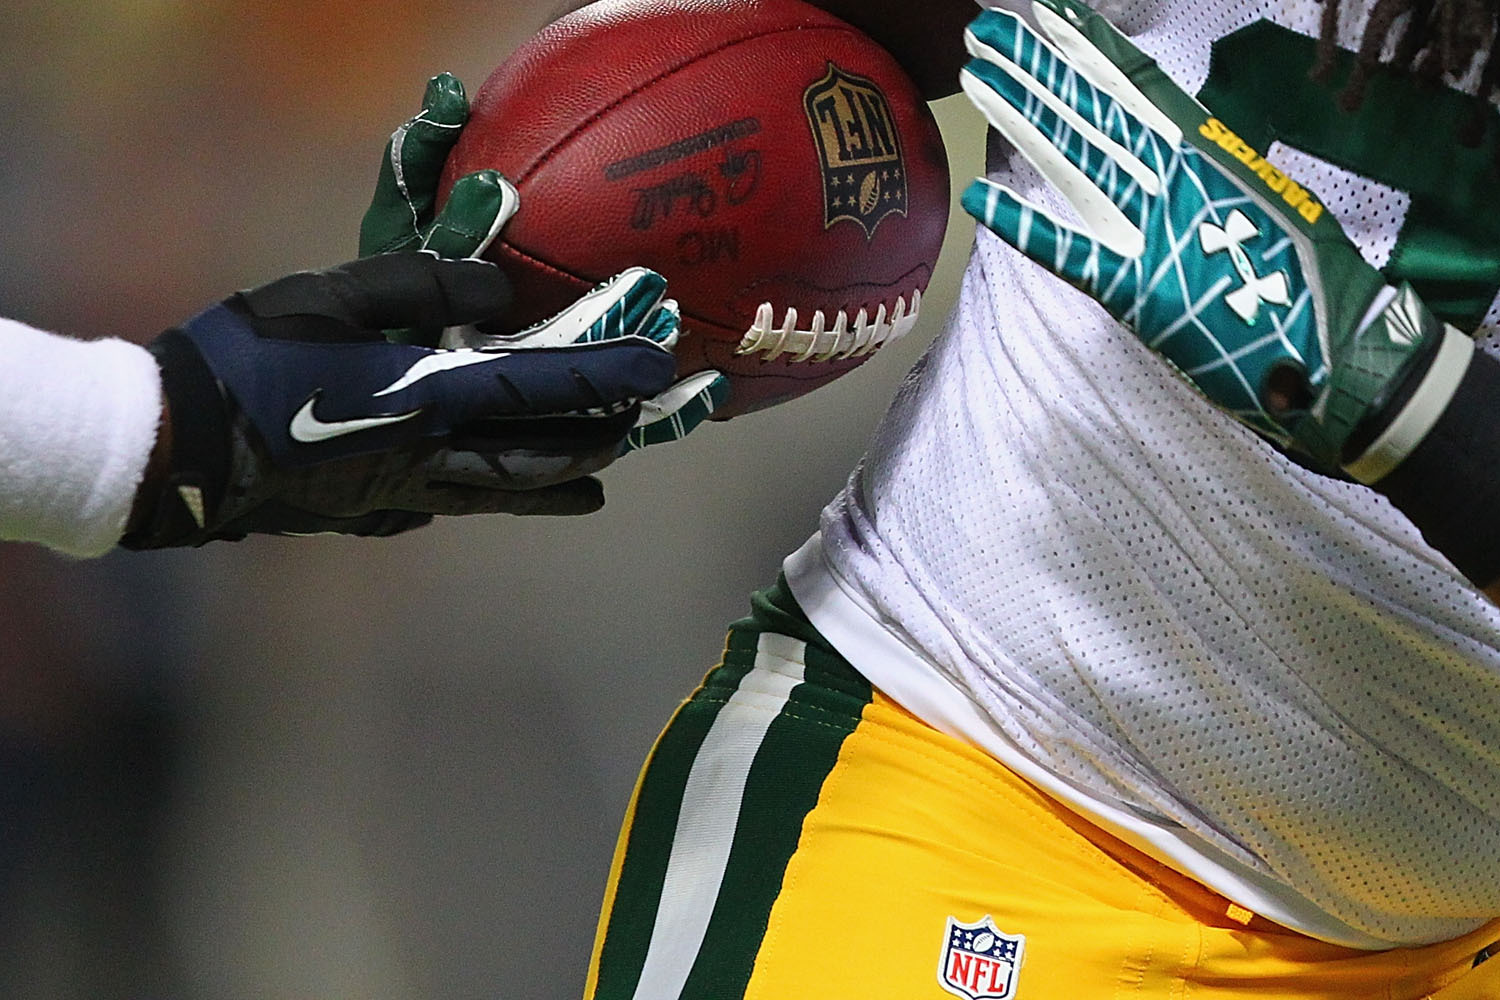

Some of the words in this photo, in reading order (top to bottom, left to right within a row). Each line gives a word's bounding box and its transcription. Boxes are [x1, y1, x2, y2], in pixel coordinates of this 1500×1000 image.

[814, 84, 897, 162] NFL
[1198, 116, 1324, 225] PACKERS
[948, 951, 1005, 994] NFL
